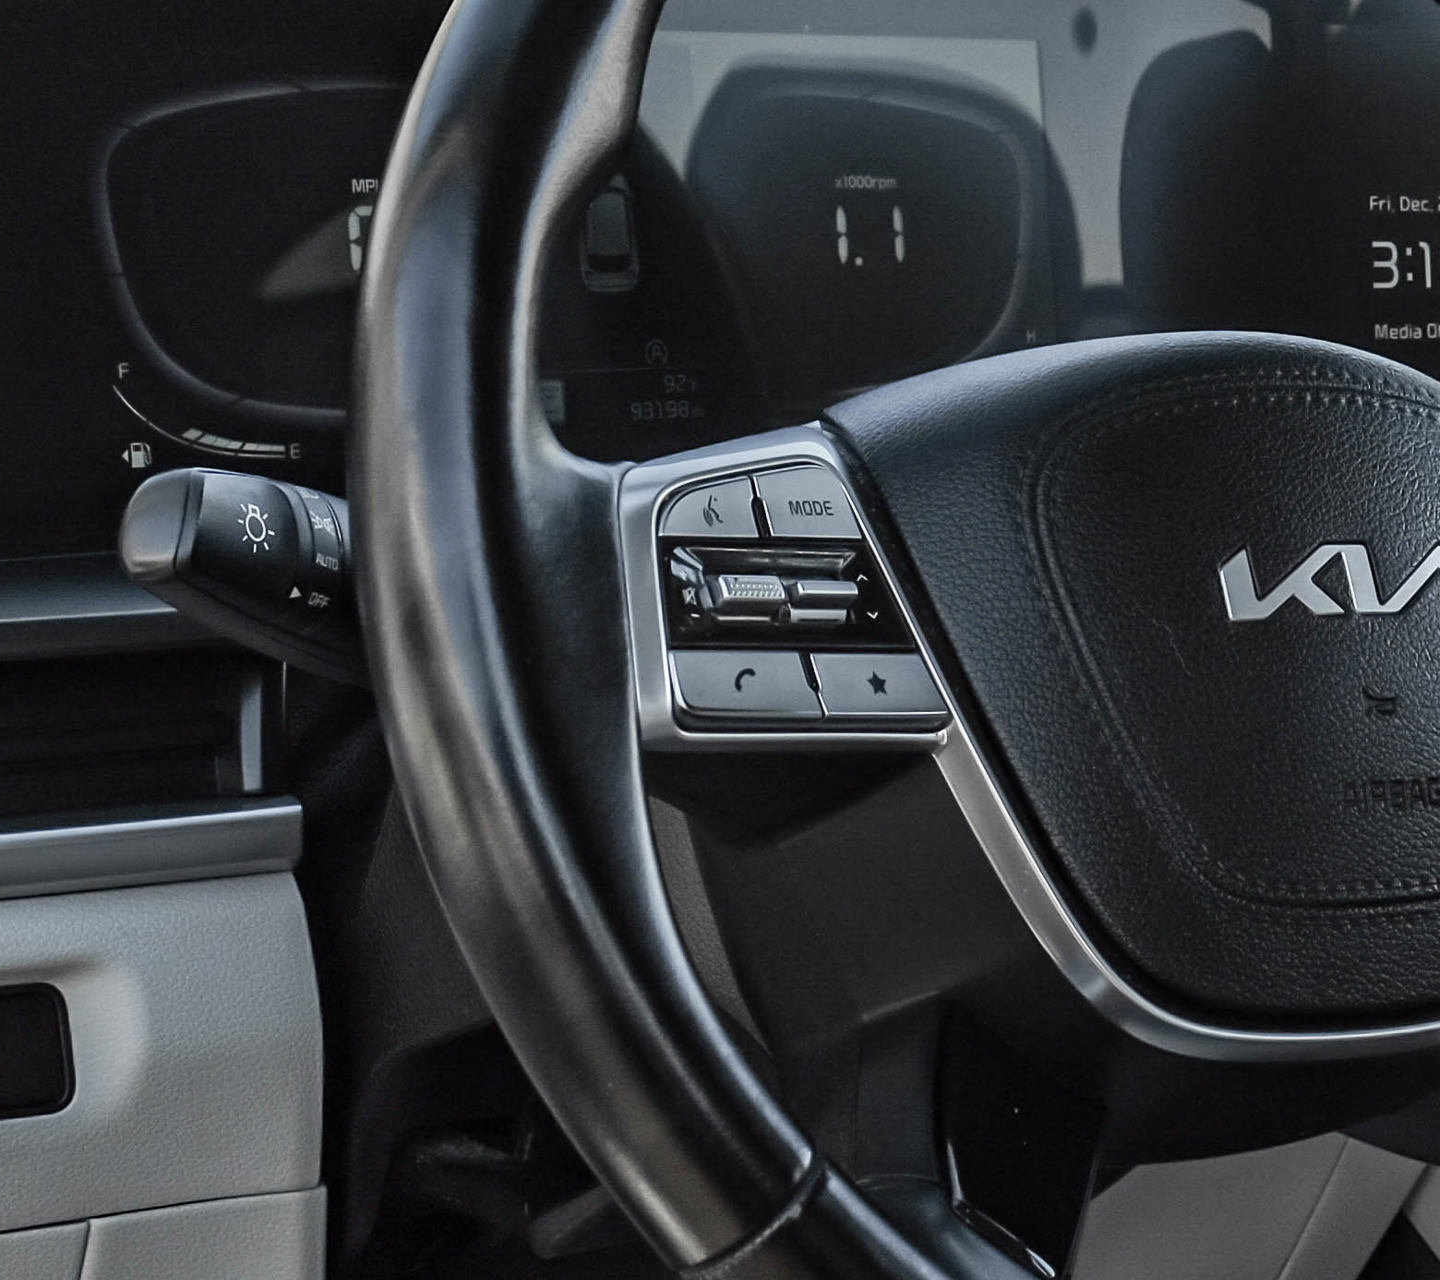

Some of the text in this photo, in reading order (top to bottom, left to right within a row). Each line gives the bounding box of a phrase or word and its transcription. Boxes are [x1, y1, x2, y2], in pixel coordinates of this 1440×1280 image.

[1399, 196, 1433, 212] Dec.
[836, 205, 904, 266] 1.1
[1374, 323, 1422, 340] Media
[118, 363, 130, 379] F
[290, 443, 302, 460] E
[788, 499, 835, 517] MODE
[315, 553, 339, 572] AUTO
[307, 592, 331, 608] OFF
